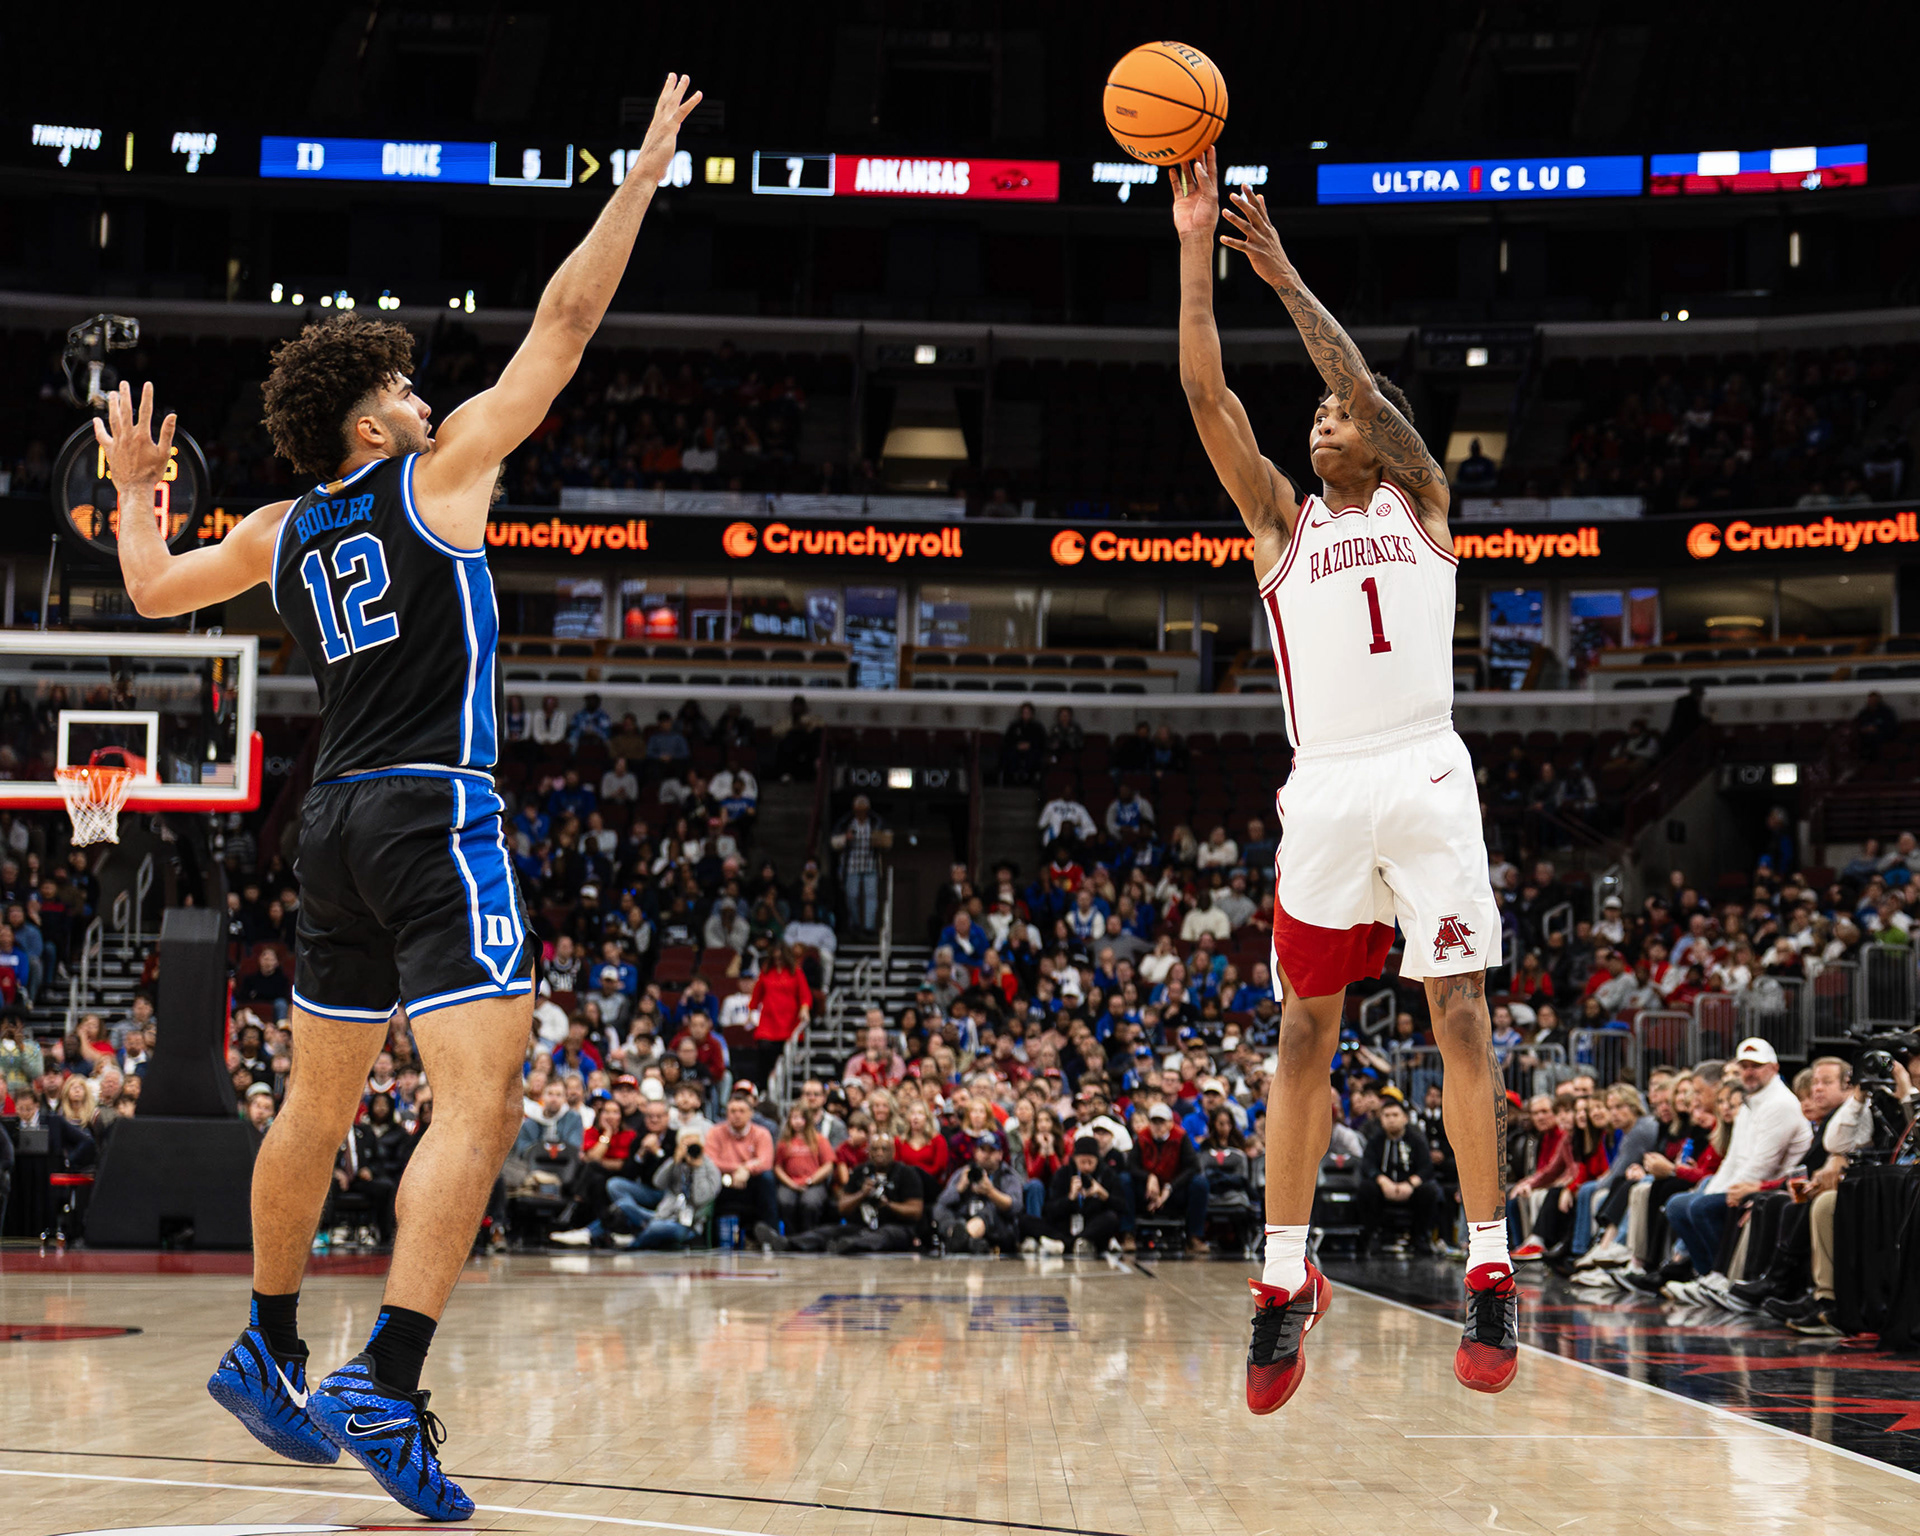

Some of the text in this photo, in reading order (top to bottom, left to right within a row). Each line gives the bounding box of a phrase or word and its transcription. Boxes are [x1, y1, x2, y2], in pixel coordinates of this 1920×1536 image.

[382, 143, 442, 177] DUKE
[786, 157, 804, 189] 7
[854, 158, 970, 195] ARKANSAS
[1372, 165, 1586, 193] ULTRA CLUB
[295, 494, 375, 544] BOOZER
[486, 518, 648, 555] unchyroll
[1724, 512, 1919, 552] Crunchyroll
[763, 523, 963, 563] Crunchyroll
[1310, 535, 1417, 584] RAZORBACKS
[1454, 527, 1601, 564] nchyroll
[300, 532, 400, 665] 12
[1361, 577, 1392, 655] 1
[484, 914, 514, 946] D
